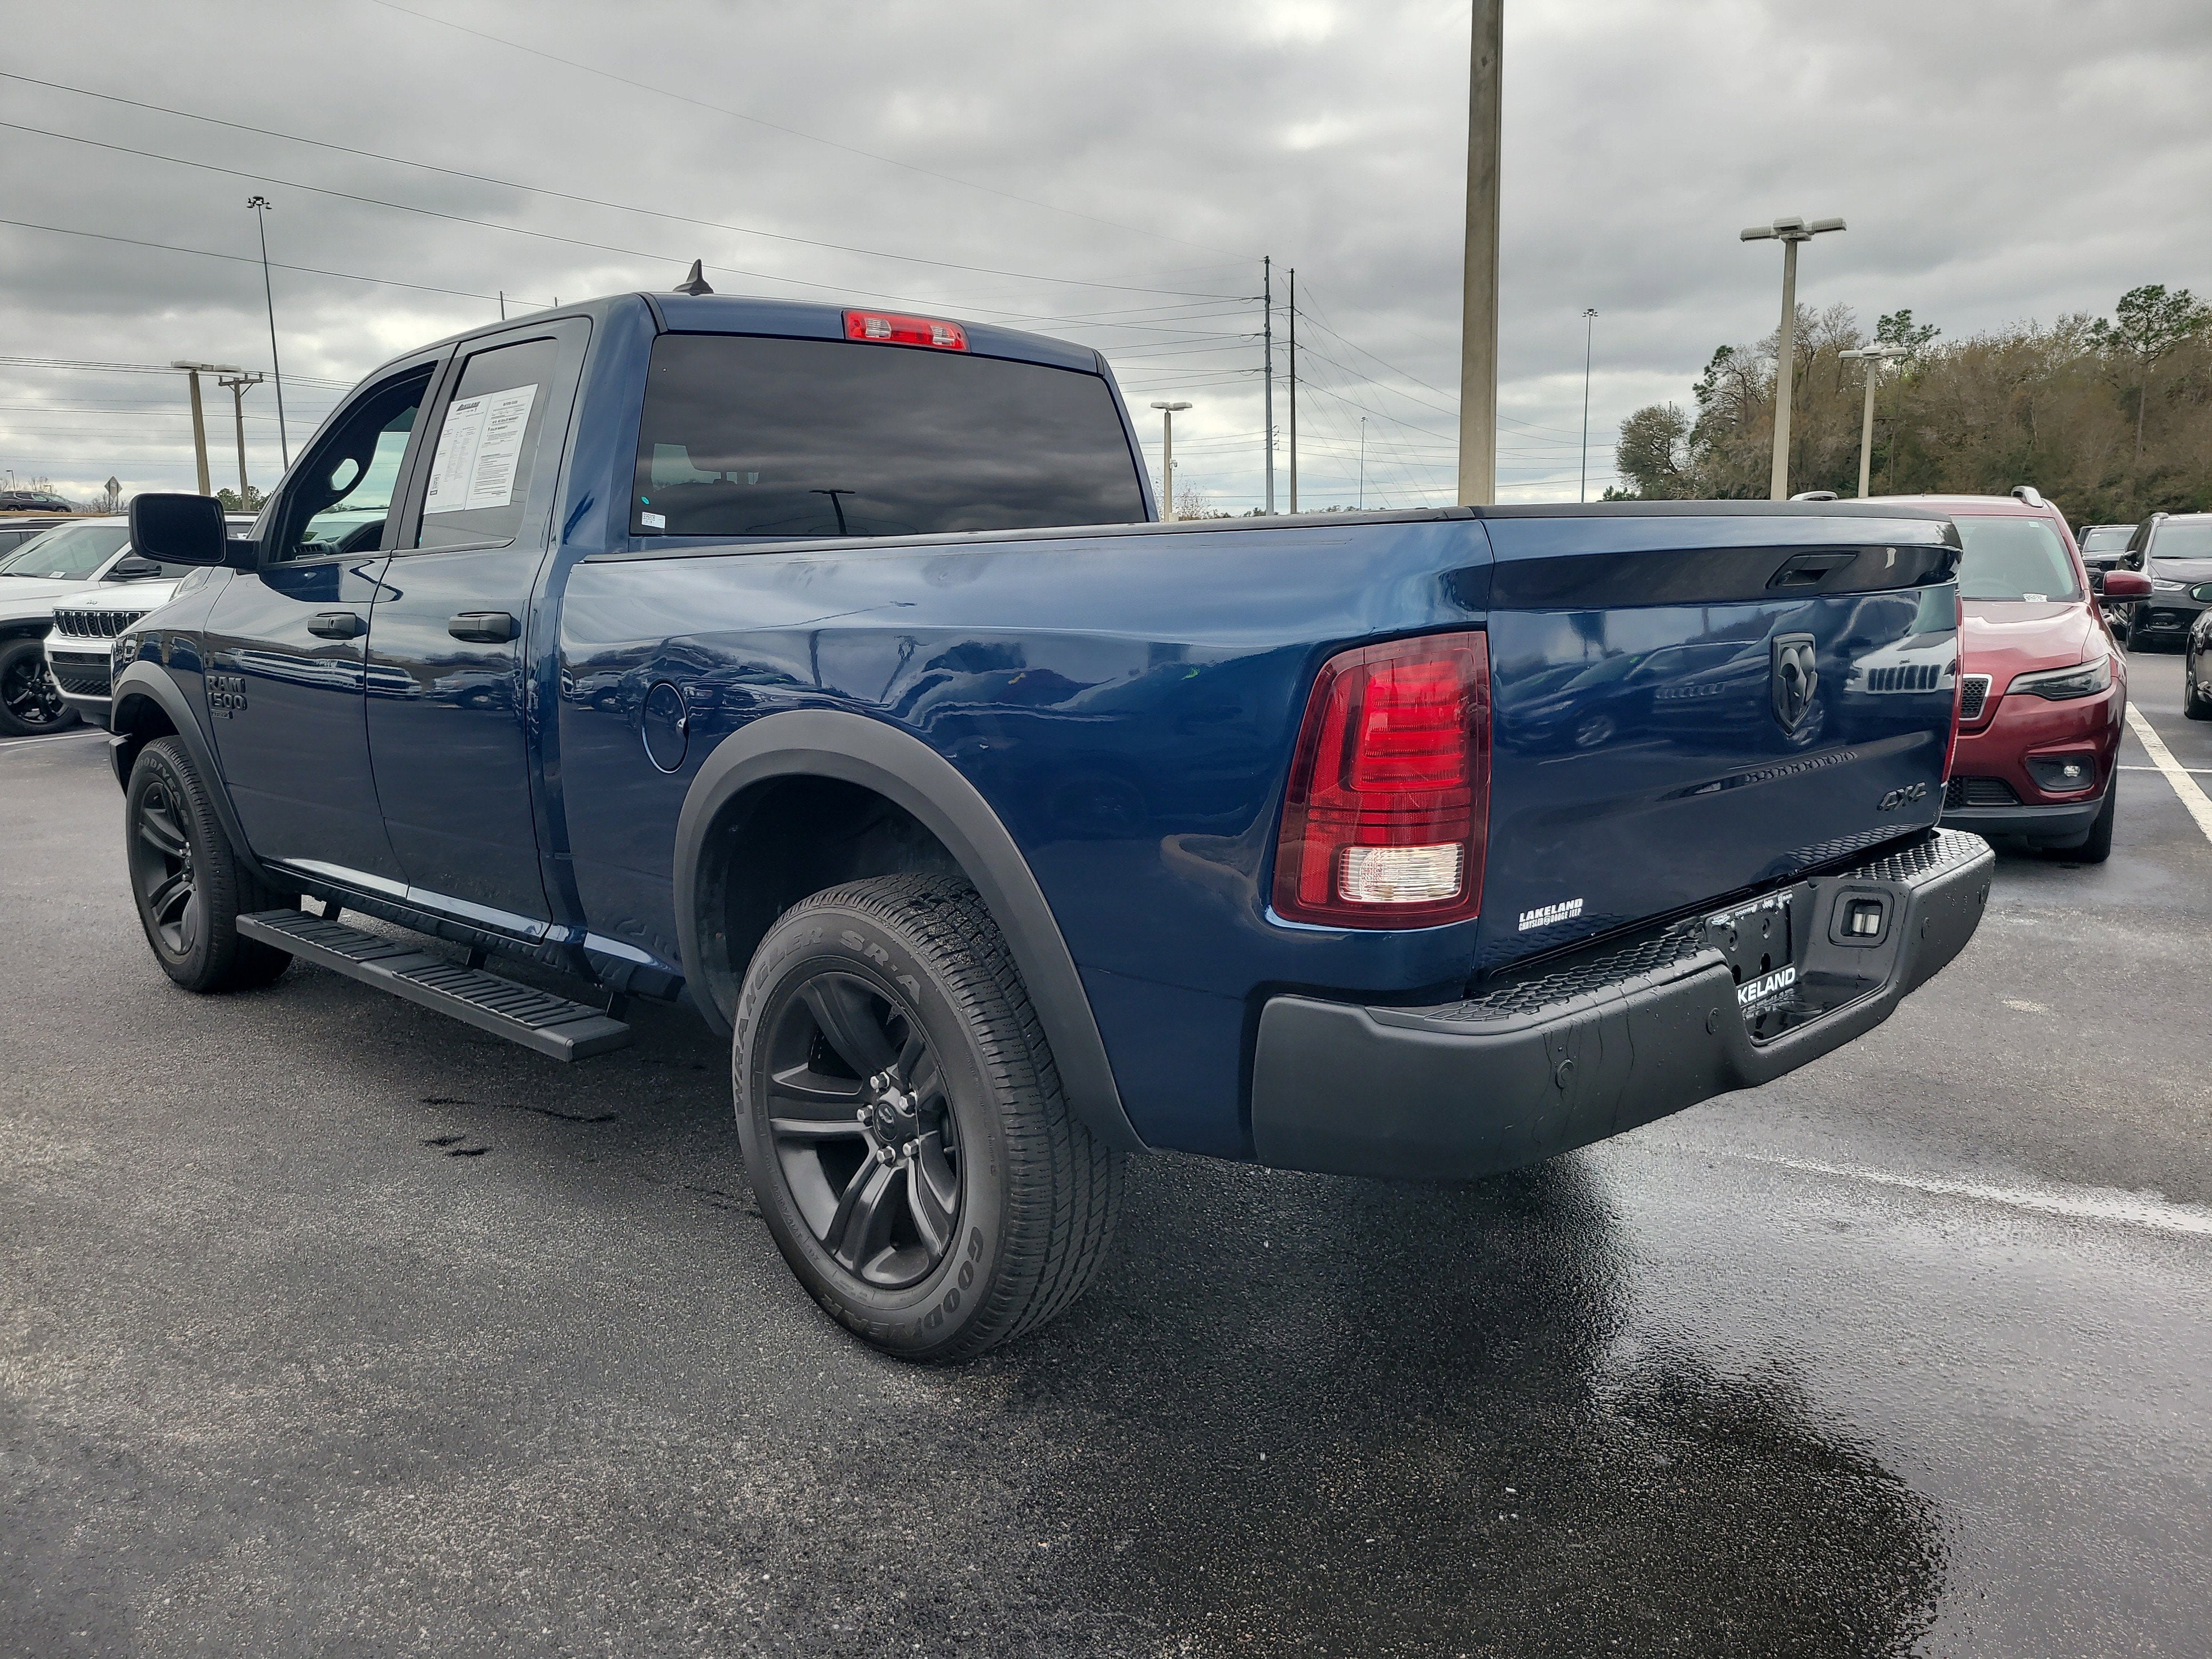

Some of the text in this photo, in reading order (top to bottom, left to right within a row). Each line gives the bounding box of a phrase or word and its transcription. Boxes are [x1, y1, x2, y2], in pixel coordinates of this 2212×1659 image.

[206, 675, 246, 693] RAM
[208, 692, 248, 710] 1500
[1518, 907, 1582, 932] CHRYSLER DODGE JEEP
[1519, 898, 1583, 923] LAKELAND
[1737, 967, 1796, 1006] KELAND
[734, 929, 823, 1115] WRANGLER
[822, 1226, 984, 1339] GOODYEAR
